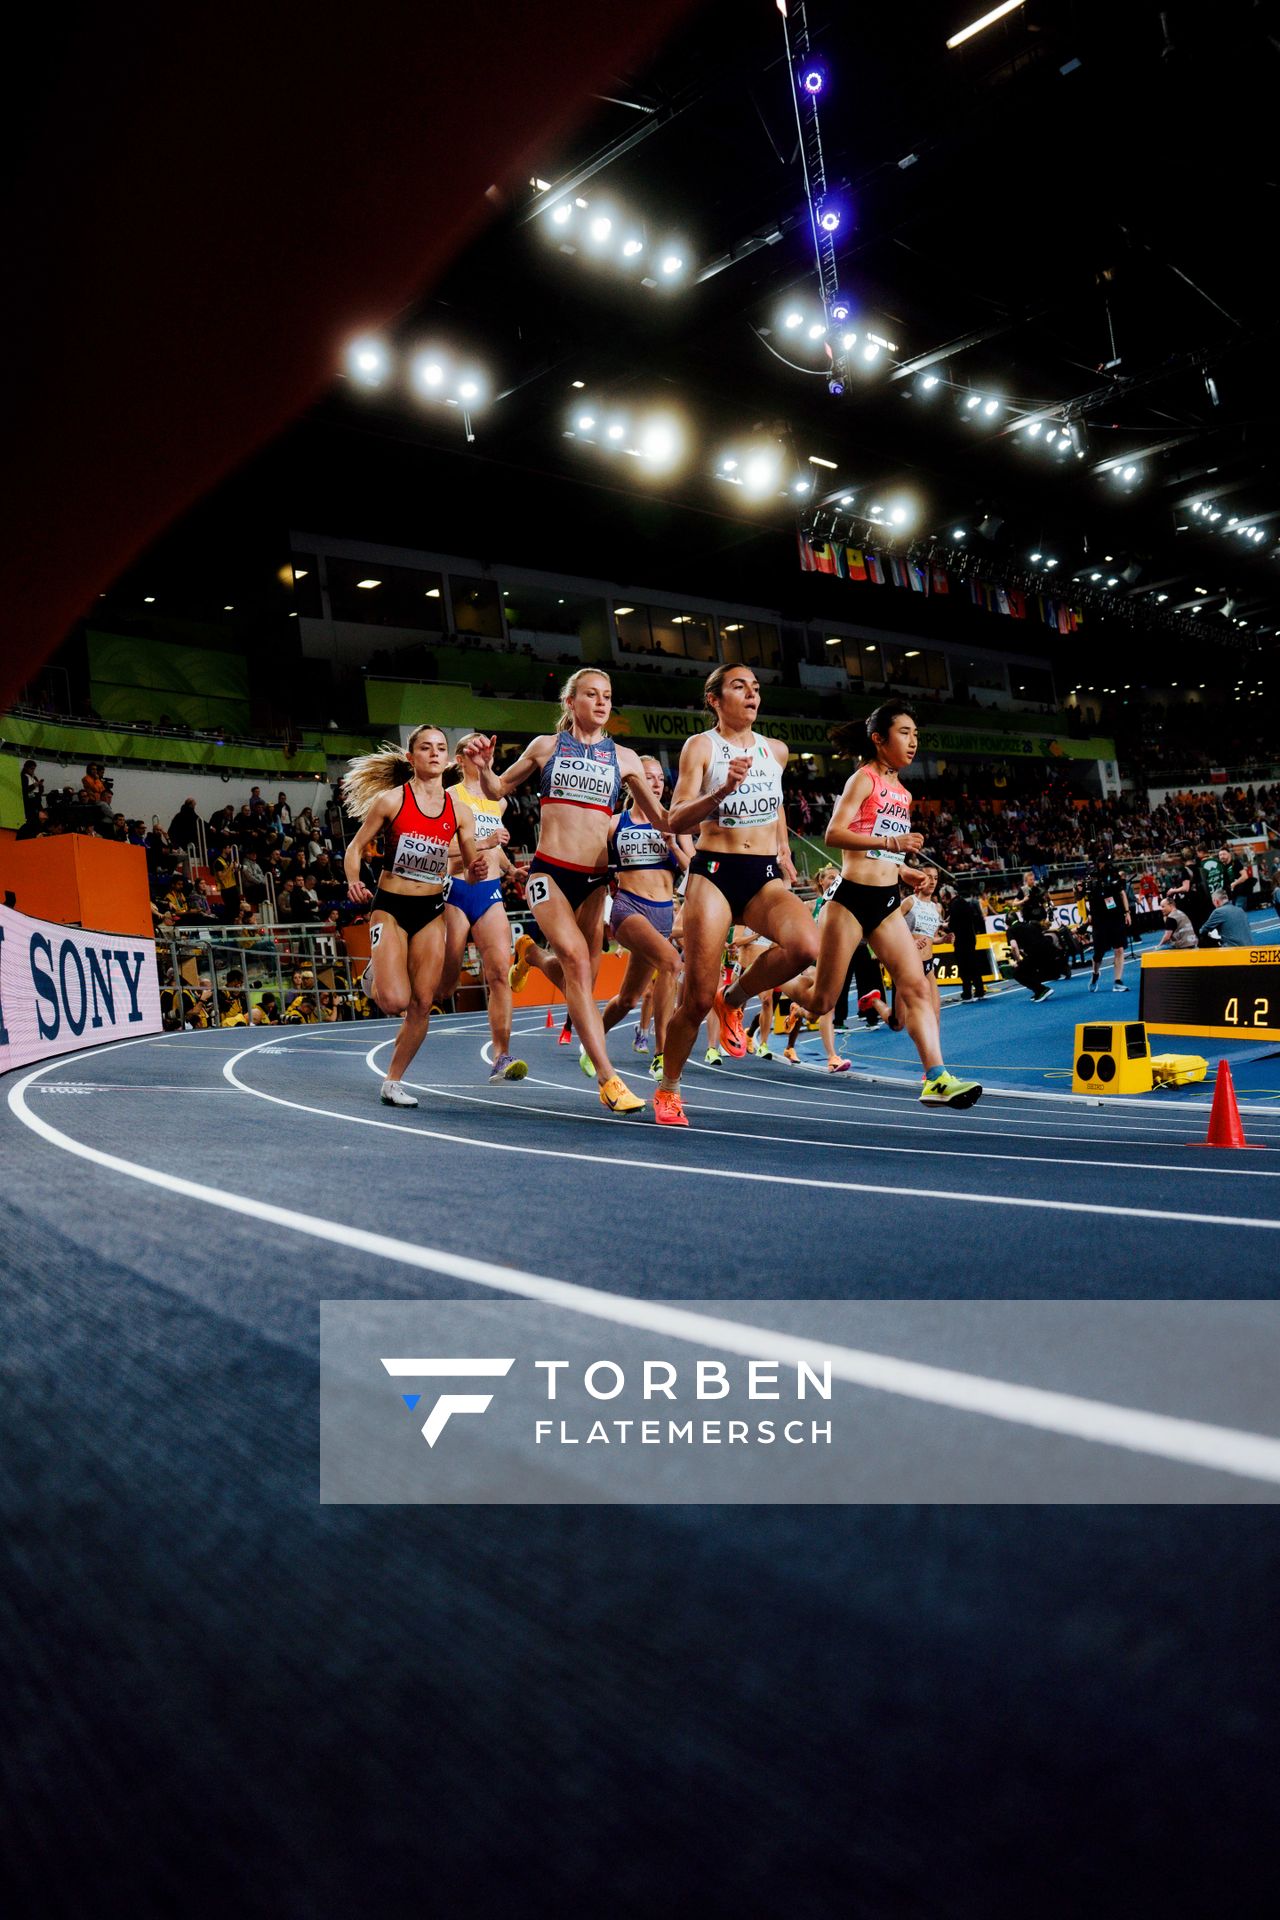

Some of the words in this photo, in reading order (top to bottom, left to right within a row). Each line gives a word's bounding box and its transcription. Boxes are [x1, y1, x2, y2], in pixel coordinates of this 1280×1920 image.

[643, 713, 704, 735] WORLD
[560, 760, 609, 776] SONY
[553, 772, 612, 795] SNOWDEN
[723, 796, 780, 816] MAJORI
[877, 802, 910, 820] JAPA
[621, 831, 661, 841] SONY
[403, 839, 447, 858] SONY
[620, 842, 667, 856] APPLETON
[397, 852, 446, 873] AYYILDIZ
[529, 880, 548, 901] 13
[370, 926, 380, 945] 15
[937, 965, 959, 980] 4.3
[29, 931, 146, 1041] SONY
[1225, 997, 1269, 1027] 4.2
[1087, 1083, 1105, 1091] SEIKO
